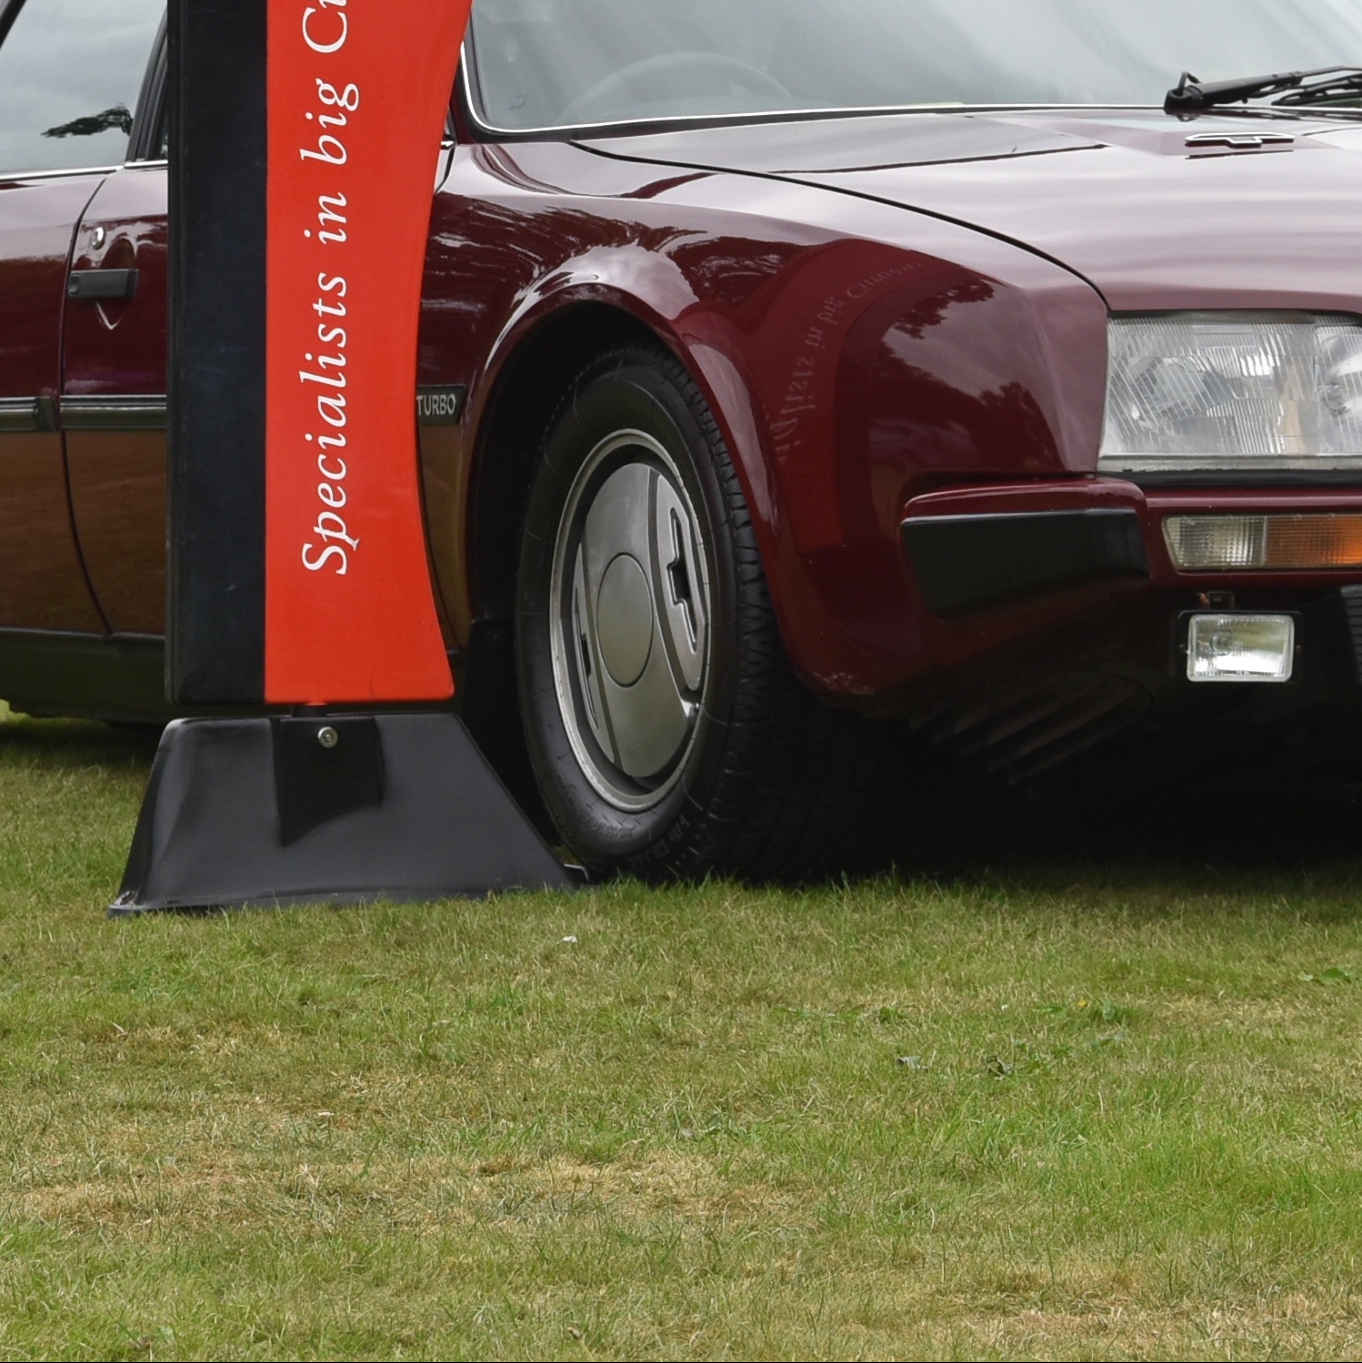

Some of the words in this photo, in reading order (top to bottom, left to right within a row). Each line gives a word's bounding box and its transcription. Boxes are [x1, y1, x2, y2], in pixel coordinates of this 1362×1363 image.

[299, 78, 359, 166] big
[302, 190, 348, 245] in
[299, 274, 360, 576] Specialists
[415, 393, 456, 416] TURBO
